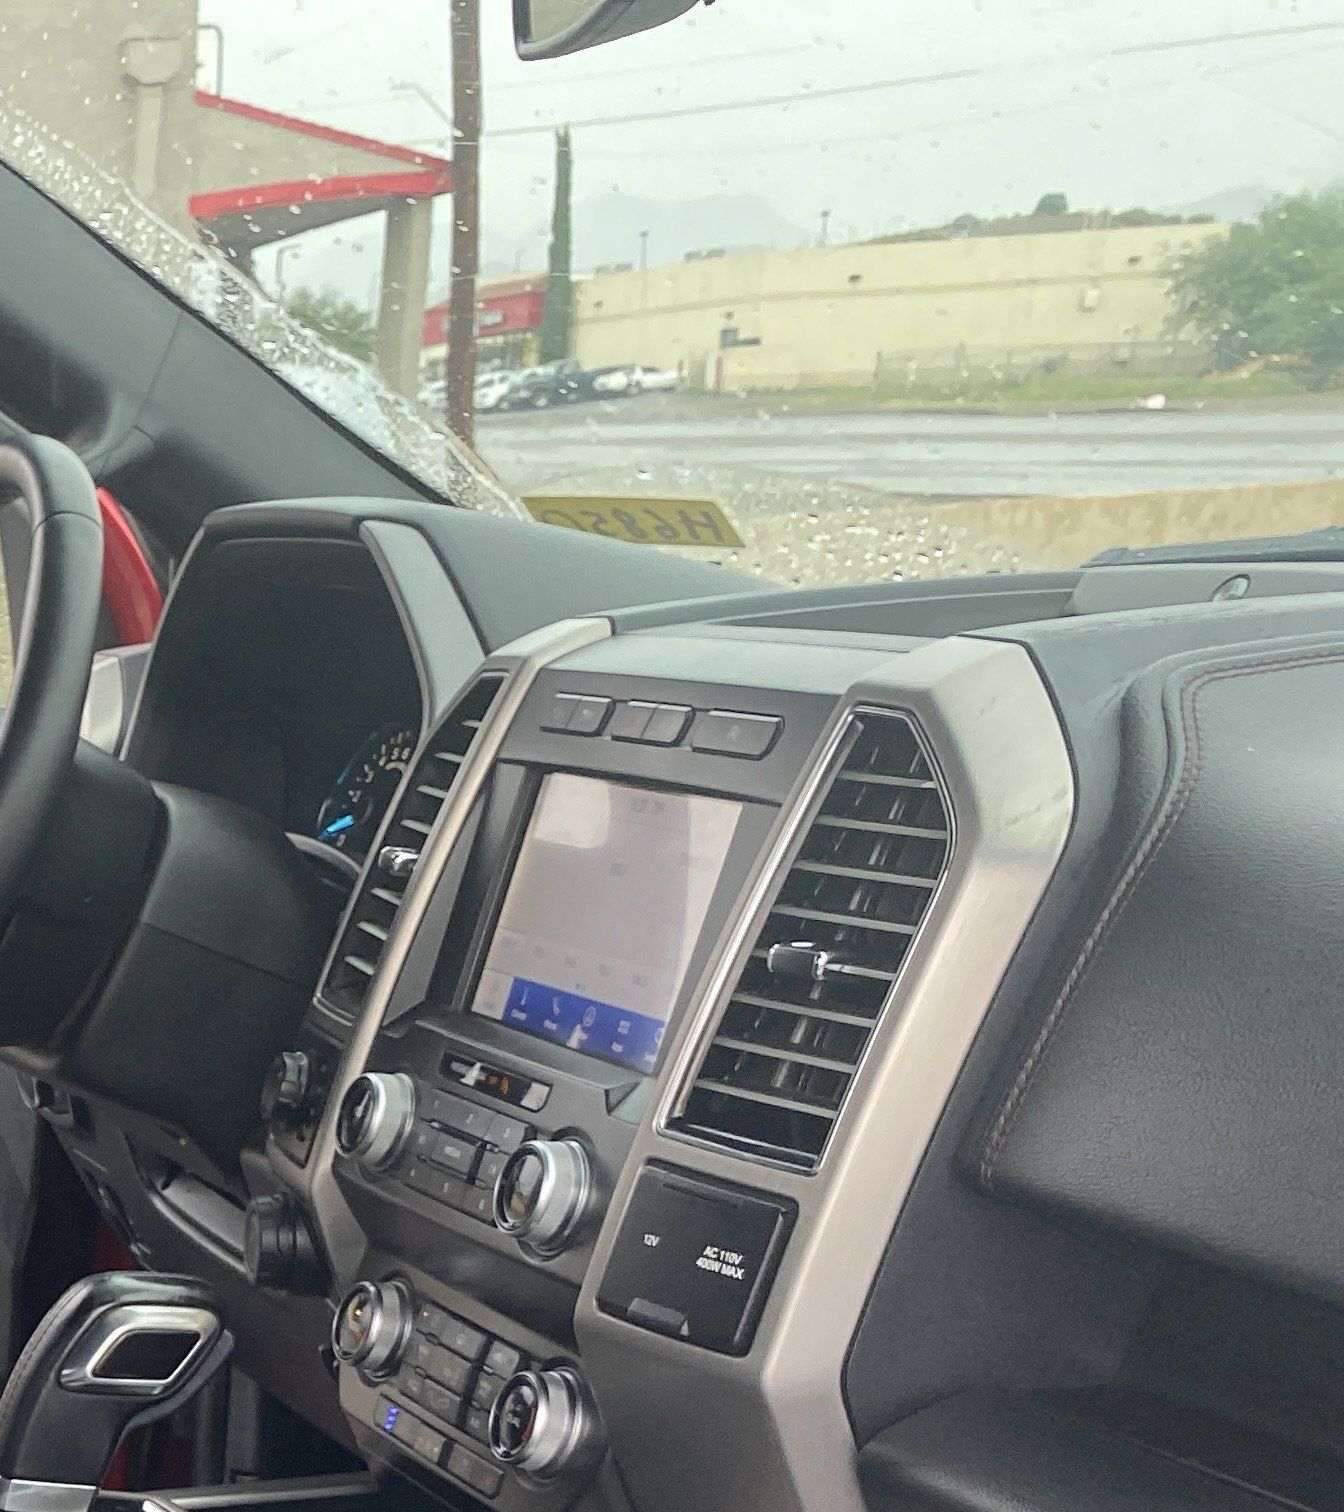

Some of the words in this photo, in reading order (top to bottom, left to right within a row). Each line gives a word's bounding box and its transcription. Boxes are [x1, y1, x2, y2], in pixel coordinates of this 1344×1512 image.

[644, 1234, 660, 1246] 12V
[703, 1246, 719, 1258] AC
[720, 1250, 743, 1264] 110V
[696, 1257, 721, 1272] 400W
[720, 1264, 744, 1279] MAX
